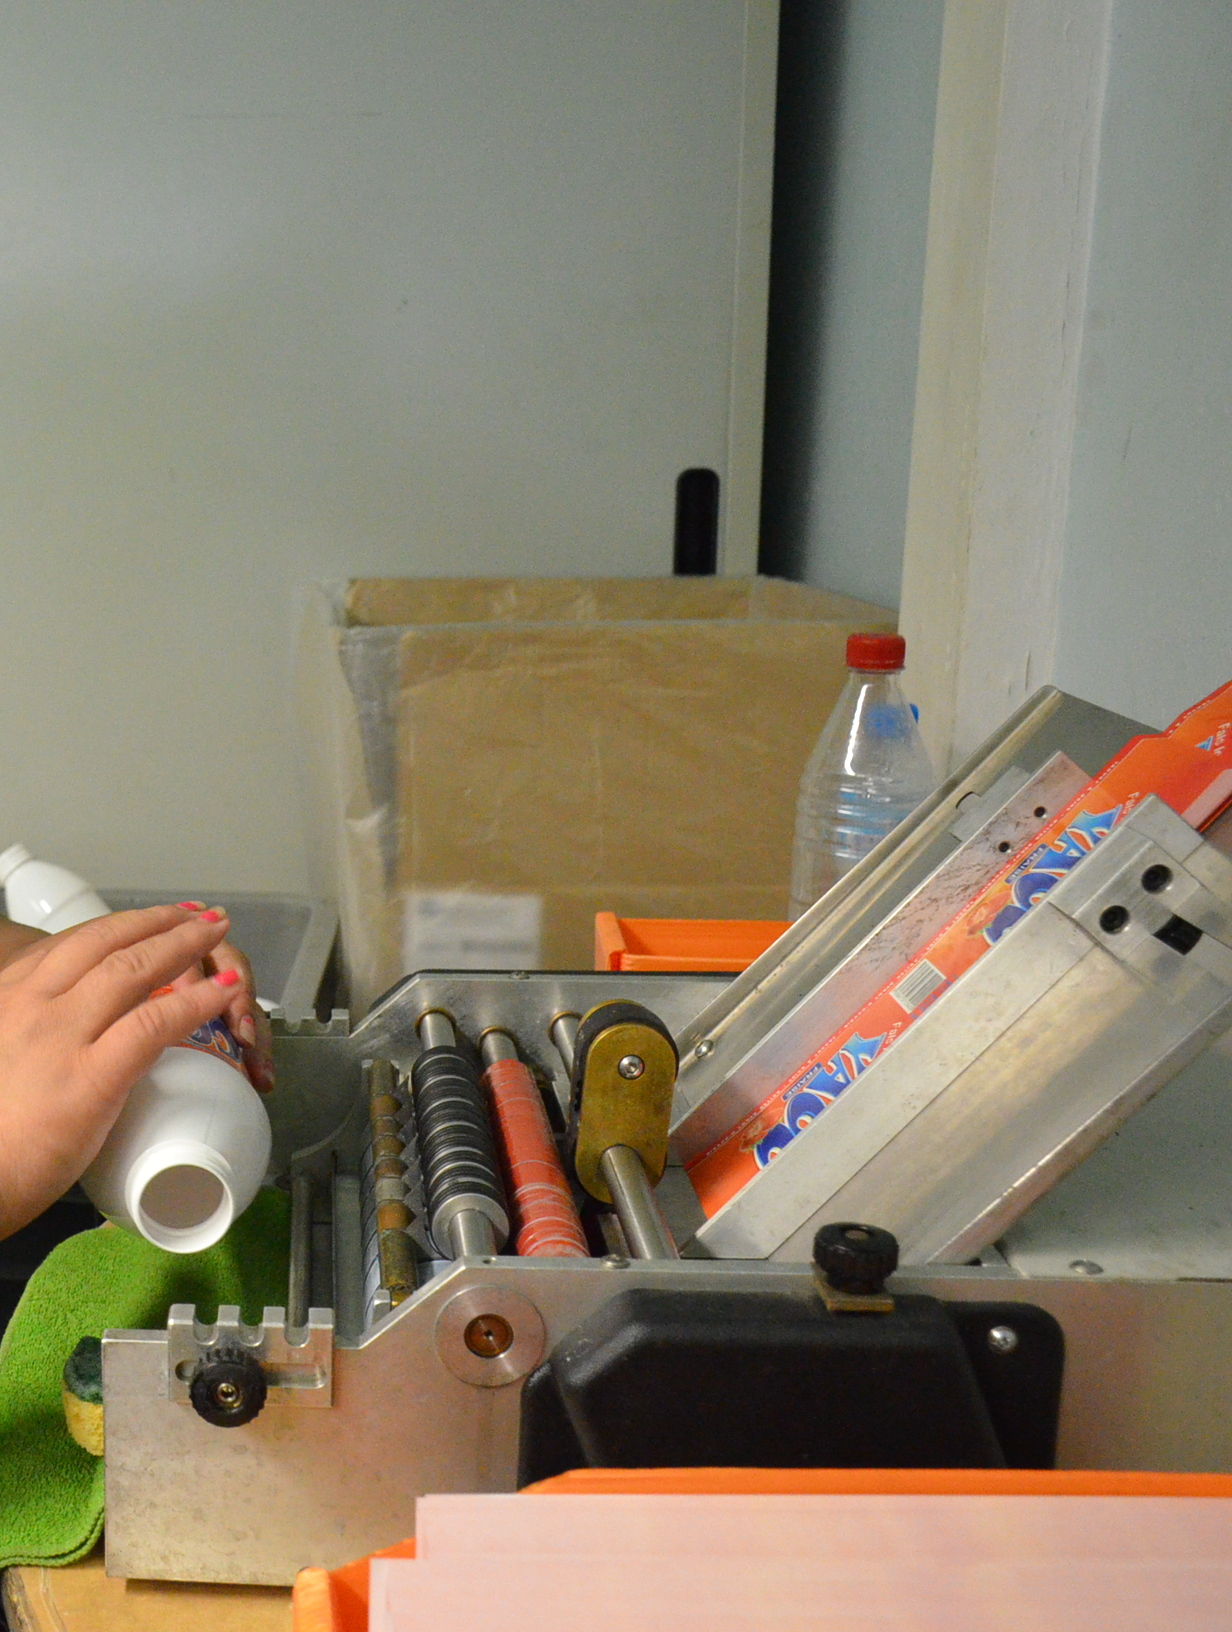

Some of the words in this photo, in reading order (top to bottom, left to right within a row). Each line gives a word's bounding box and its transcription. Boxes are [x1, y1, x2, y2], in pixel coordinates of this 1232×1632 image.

[1214, 721, 1231, 746] Fais
[1008, 844, 1046, 881] FRAISE
[884, 1020, 903, 1045] Fais
[785, 1064, 821, 1099] FRAISE
